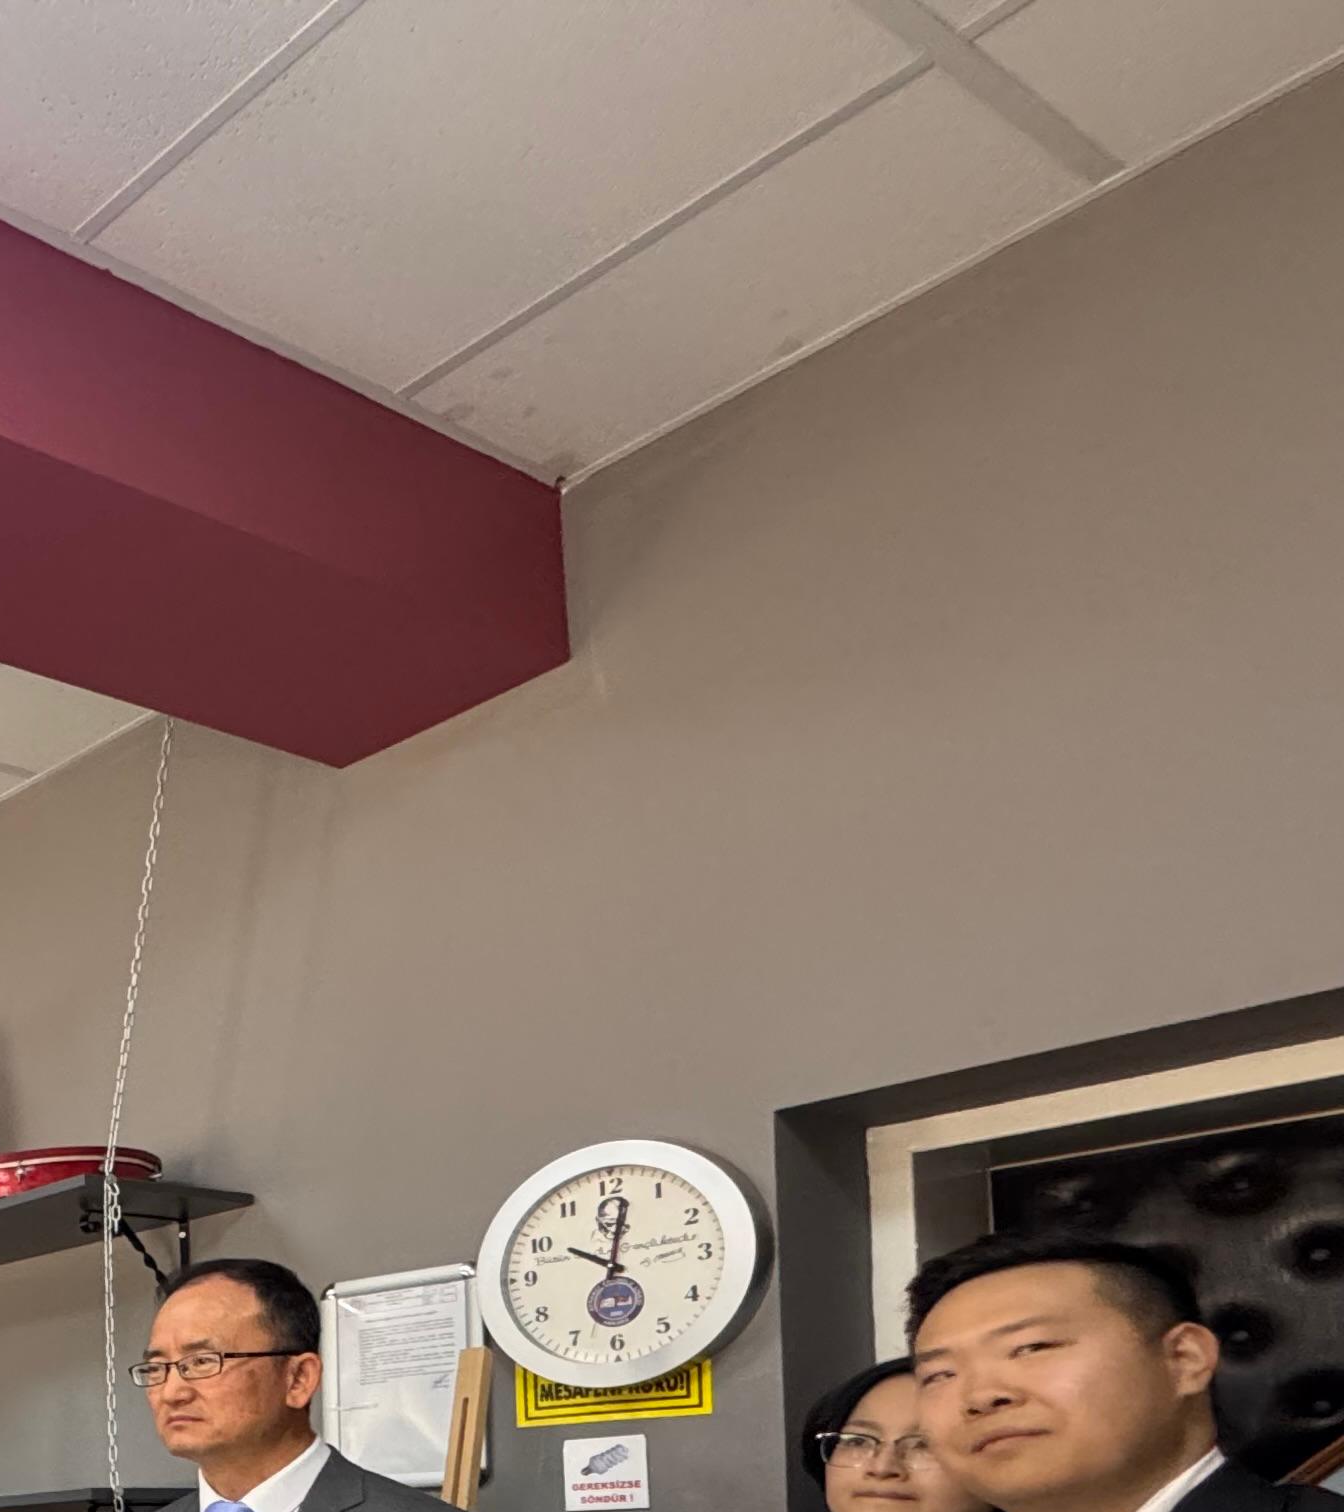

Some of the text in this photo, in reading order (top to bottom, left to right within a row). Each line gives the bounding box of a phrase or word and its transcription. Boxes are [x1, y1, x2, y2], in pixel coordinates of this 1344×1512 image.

[599, 1177, 623, 1196] 12
[655, 1182, 662, 1199] 1
[560, 1201, 576, 1218] 11
[684, 1207, 699, 1226] 2
[531, 1236, 553, 1253] 10
[697, 1242, 712, 1260] 3
[524, 1270, 538, 1287] 9
[684, 1284, 699, 1302] 4
[535, 1306, 549, 1323] 8
[656, 1316, 671, 1334] 5
[568, 1330, 581, 1346] 7
[610, 1333, 625, 1351] 6
[572, 1480, 641, 1491] GEREKSİZSE
